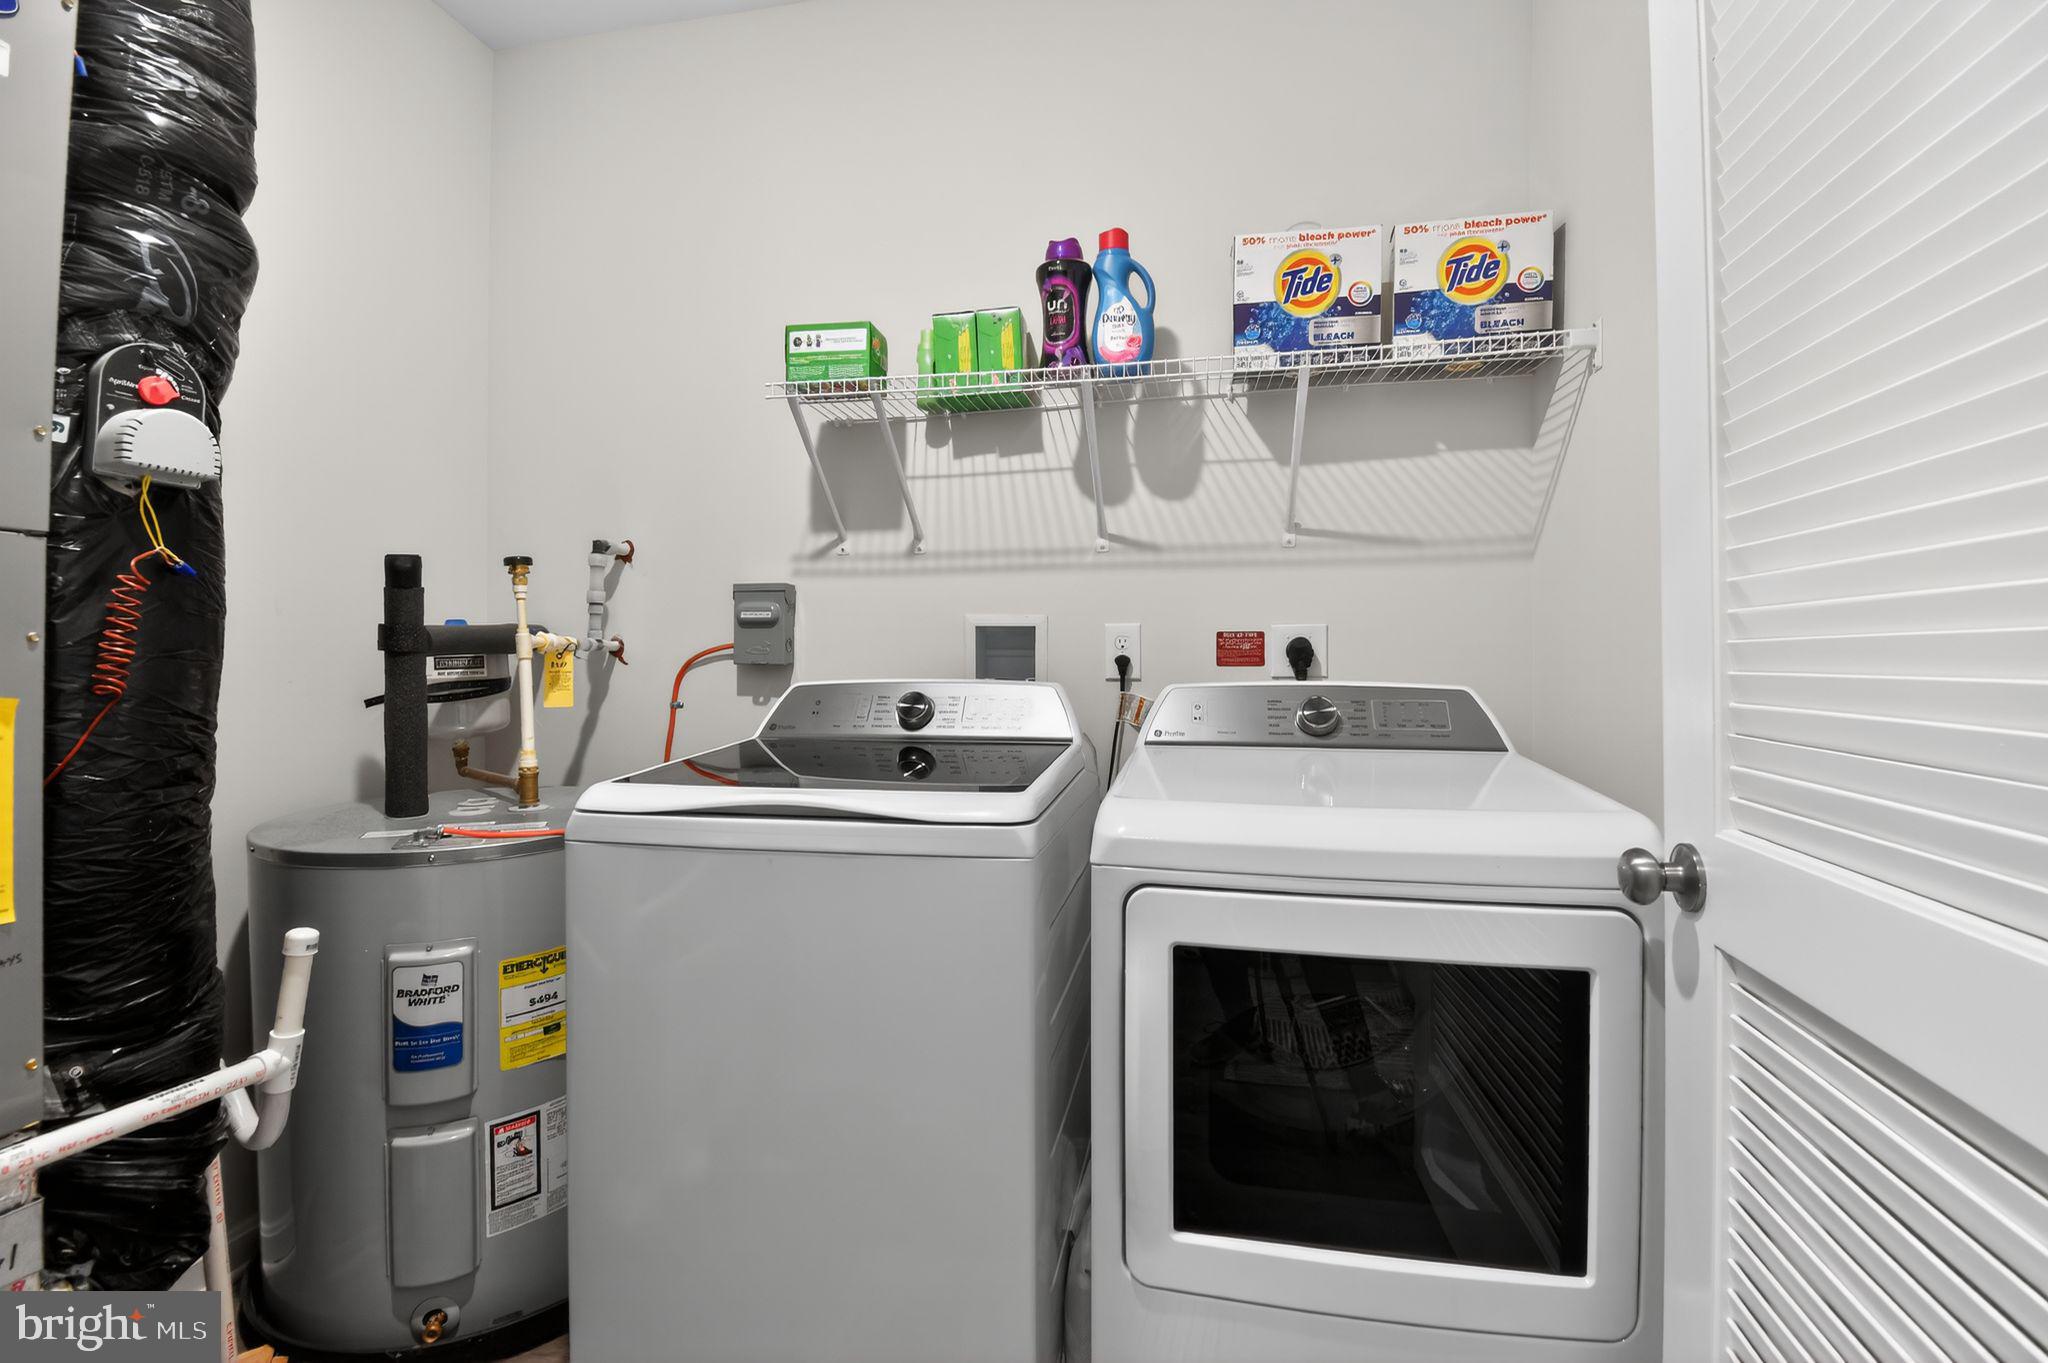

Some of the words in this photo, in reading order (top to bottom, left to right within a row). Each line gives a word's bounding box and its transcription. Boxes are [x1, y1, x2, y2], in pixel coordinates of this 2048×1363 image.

[1403, 225, 1429, 235] 50%
[1432, 223, 1461, 232] more
[1464, 217, 1502, 229] bleach
[1242, 236, 1265, 246] 50%
[1298, 231, 1335, 242] bleach
[1446, 252, 1501, 292] Tide
[1281, 266, 1334, 304] Tide
[1480, 318, 1525, 329] BLEACH
[1313, 331, 1355, 341] BLEACH
[396, 984, 460, 998] BRADFORD
[408, 996, 446, 1007] WHITE
